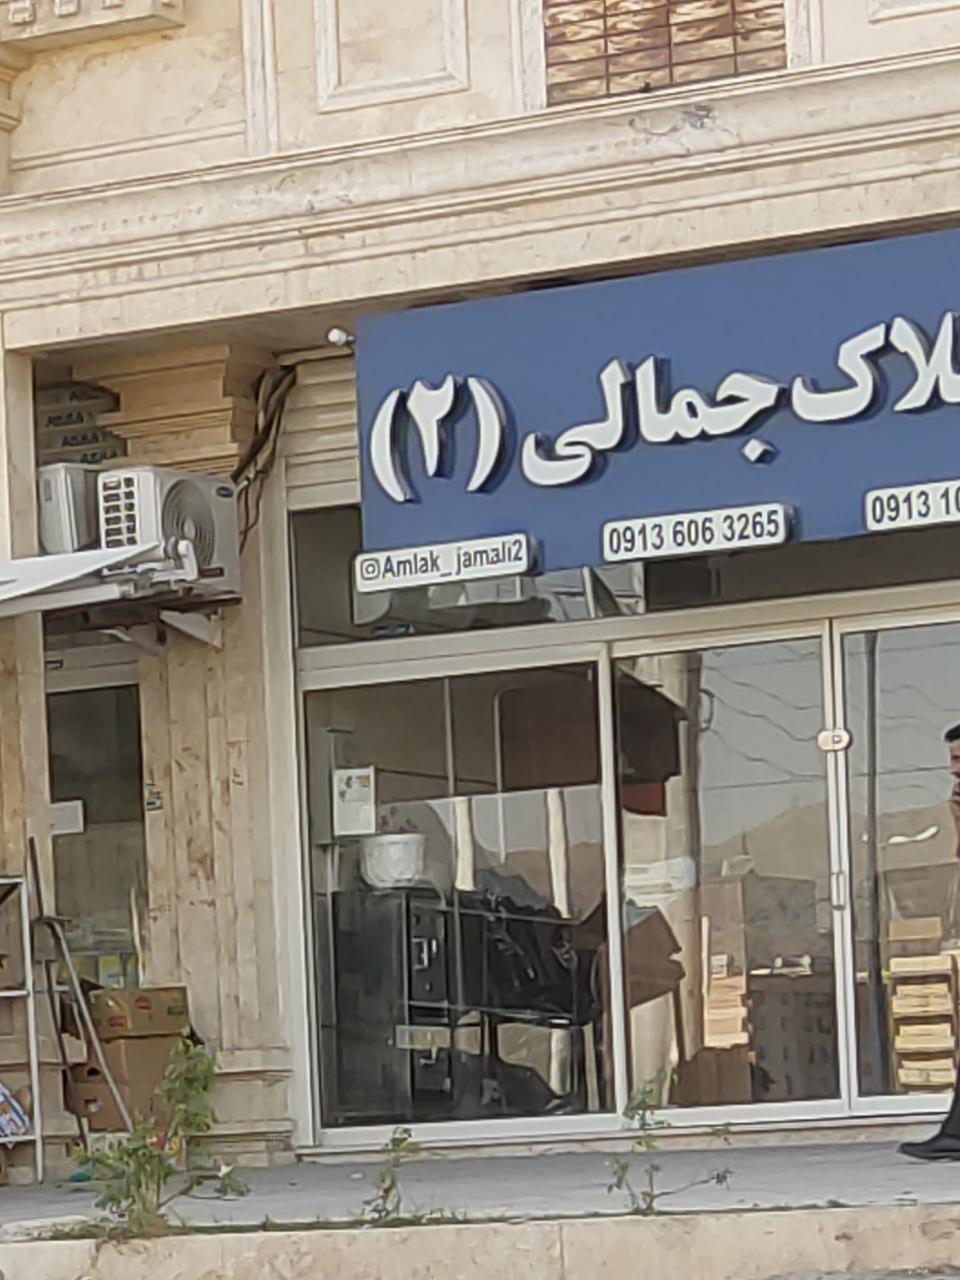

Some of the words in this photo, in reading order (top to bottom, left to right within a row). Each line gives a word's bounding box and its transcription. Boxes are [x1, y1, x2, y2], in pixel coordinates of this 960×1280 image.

[521, 354, 783, 487] جمالی
[871, 489, 932, 524] 0913
[609, 523, 665, 555] 0913
[672, 516, 715, 548] 606
[722, 509, 780, 541] 3265
